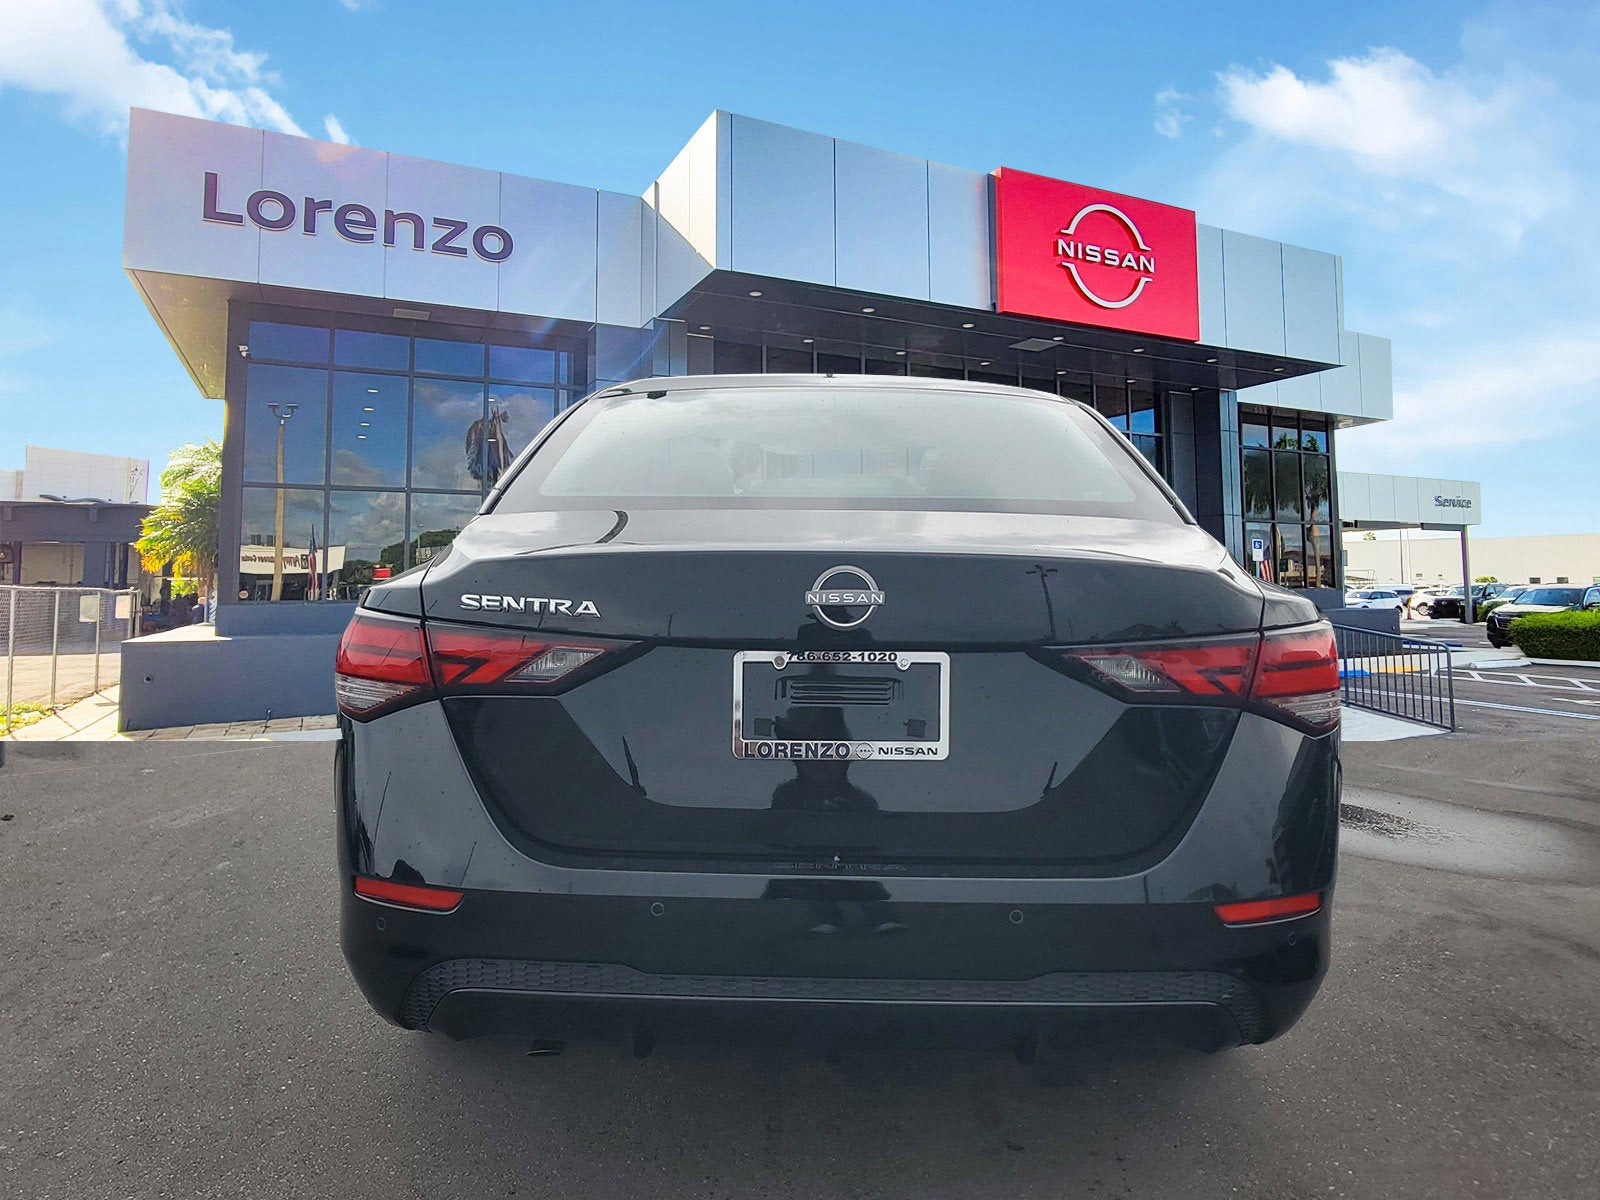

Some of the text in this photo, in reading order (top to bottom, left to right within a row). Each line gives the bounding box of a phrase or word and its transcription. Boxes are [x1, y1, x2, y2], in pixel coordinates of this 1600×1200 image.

[202, 171, 514, 262] Lorenzo
[1057, 238, 1155, 273] NISSAN
[1434, 495, 1472, 509] Service
[459, 593, 602, 618] SENTRA
[807, 593, 883, 603] NISSAN
[743, 742, 938, 759] LORENZO NISSAN
